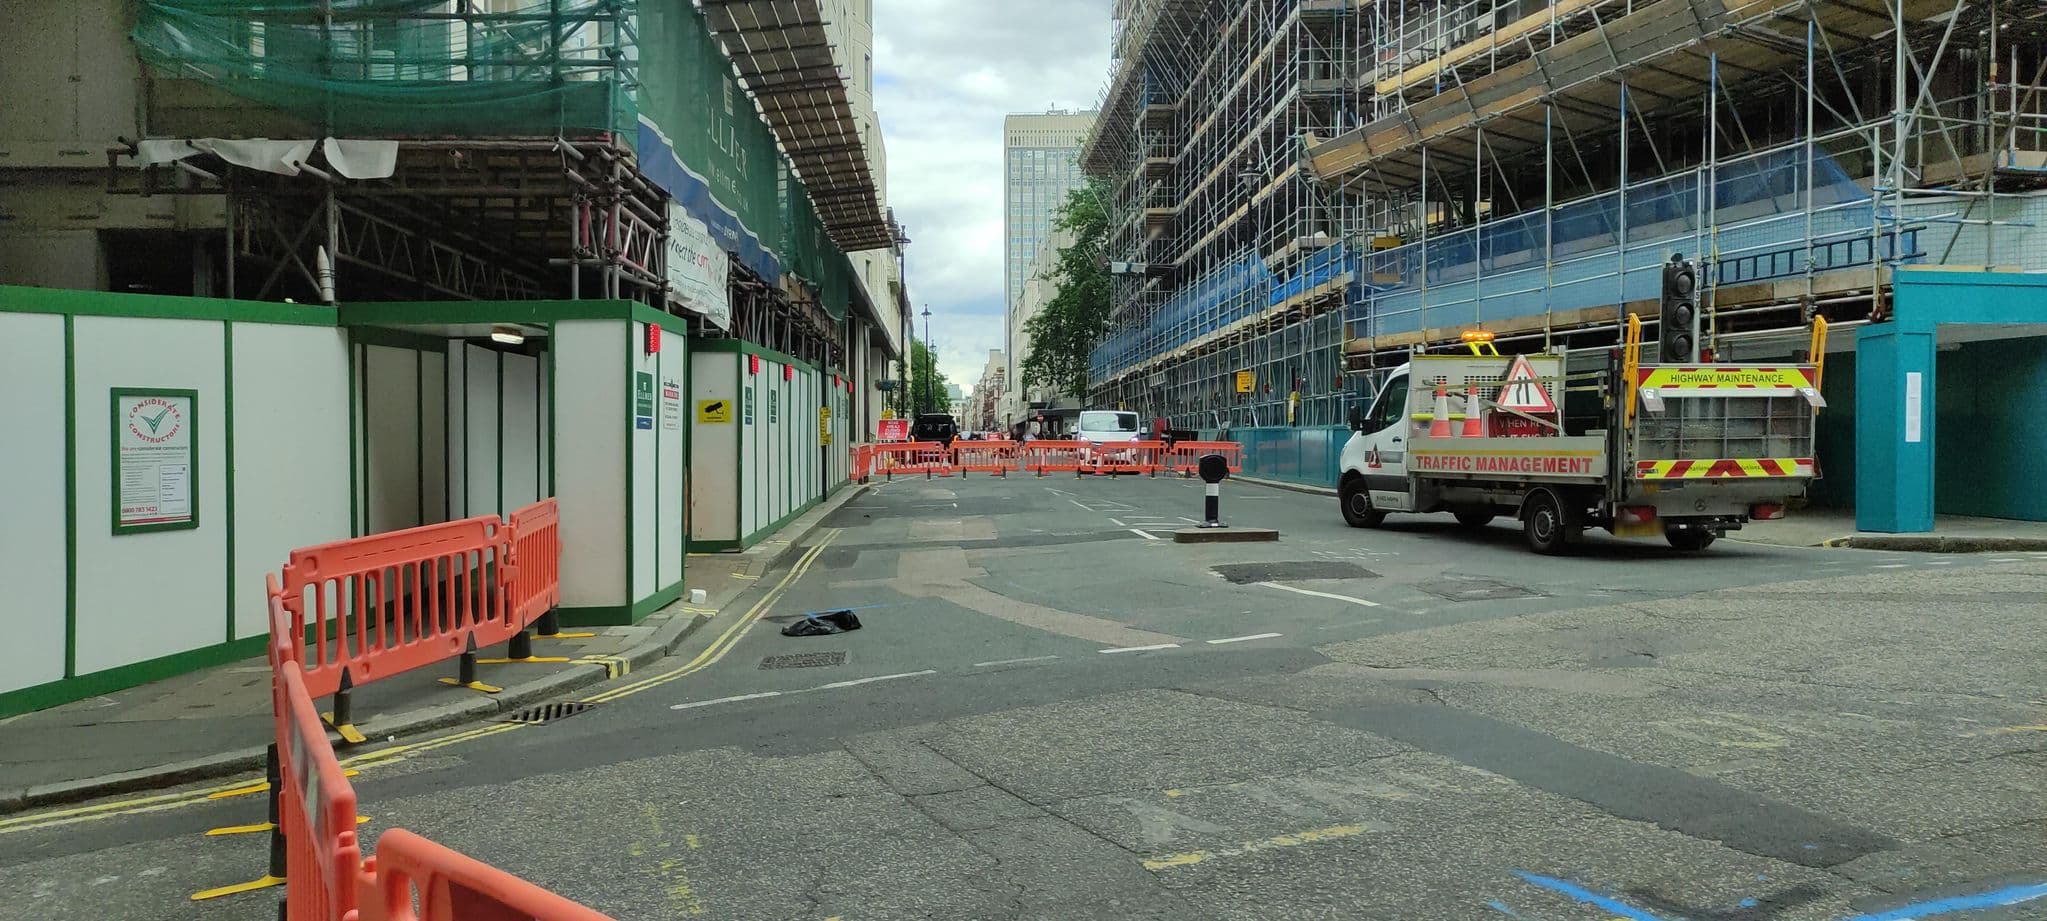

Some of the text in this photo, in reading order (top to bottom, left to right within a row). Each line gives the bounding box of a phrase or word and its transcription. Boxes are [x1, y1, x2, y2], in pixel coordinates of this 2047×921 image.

[1670, 374, 1784, 383] HIGHWAY MAINTENANCE
[129, 398, 181, 418] CONSIDERATE
[128, 423, 180, 443] CONSTRUCTORS
[1415, 455, 1593, 473] TRAFFIC MANAGEMENT
